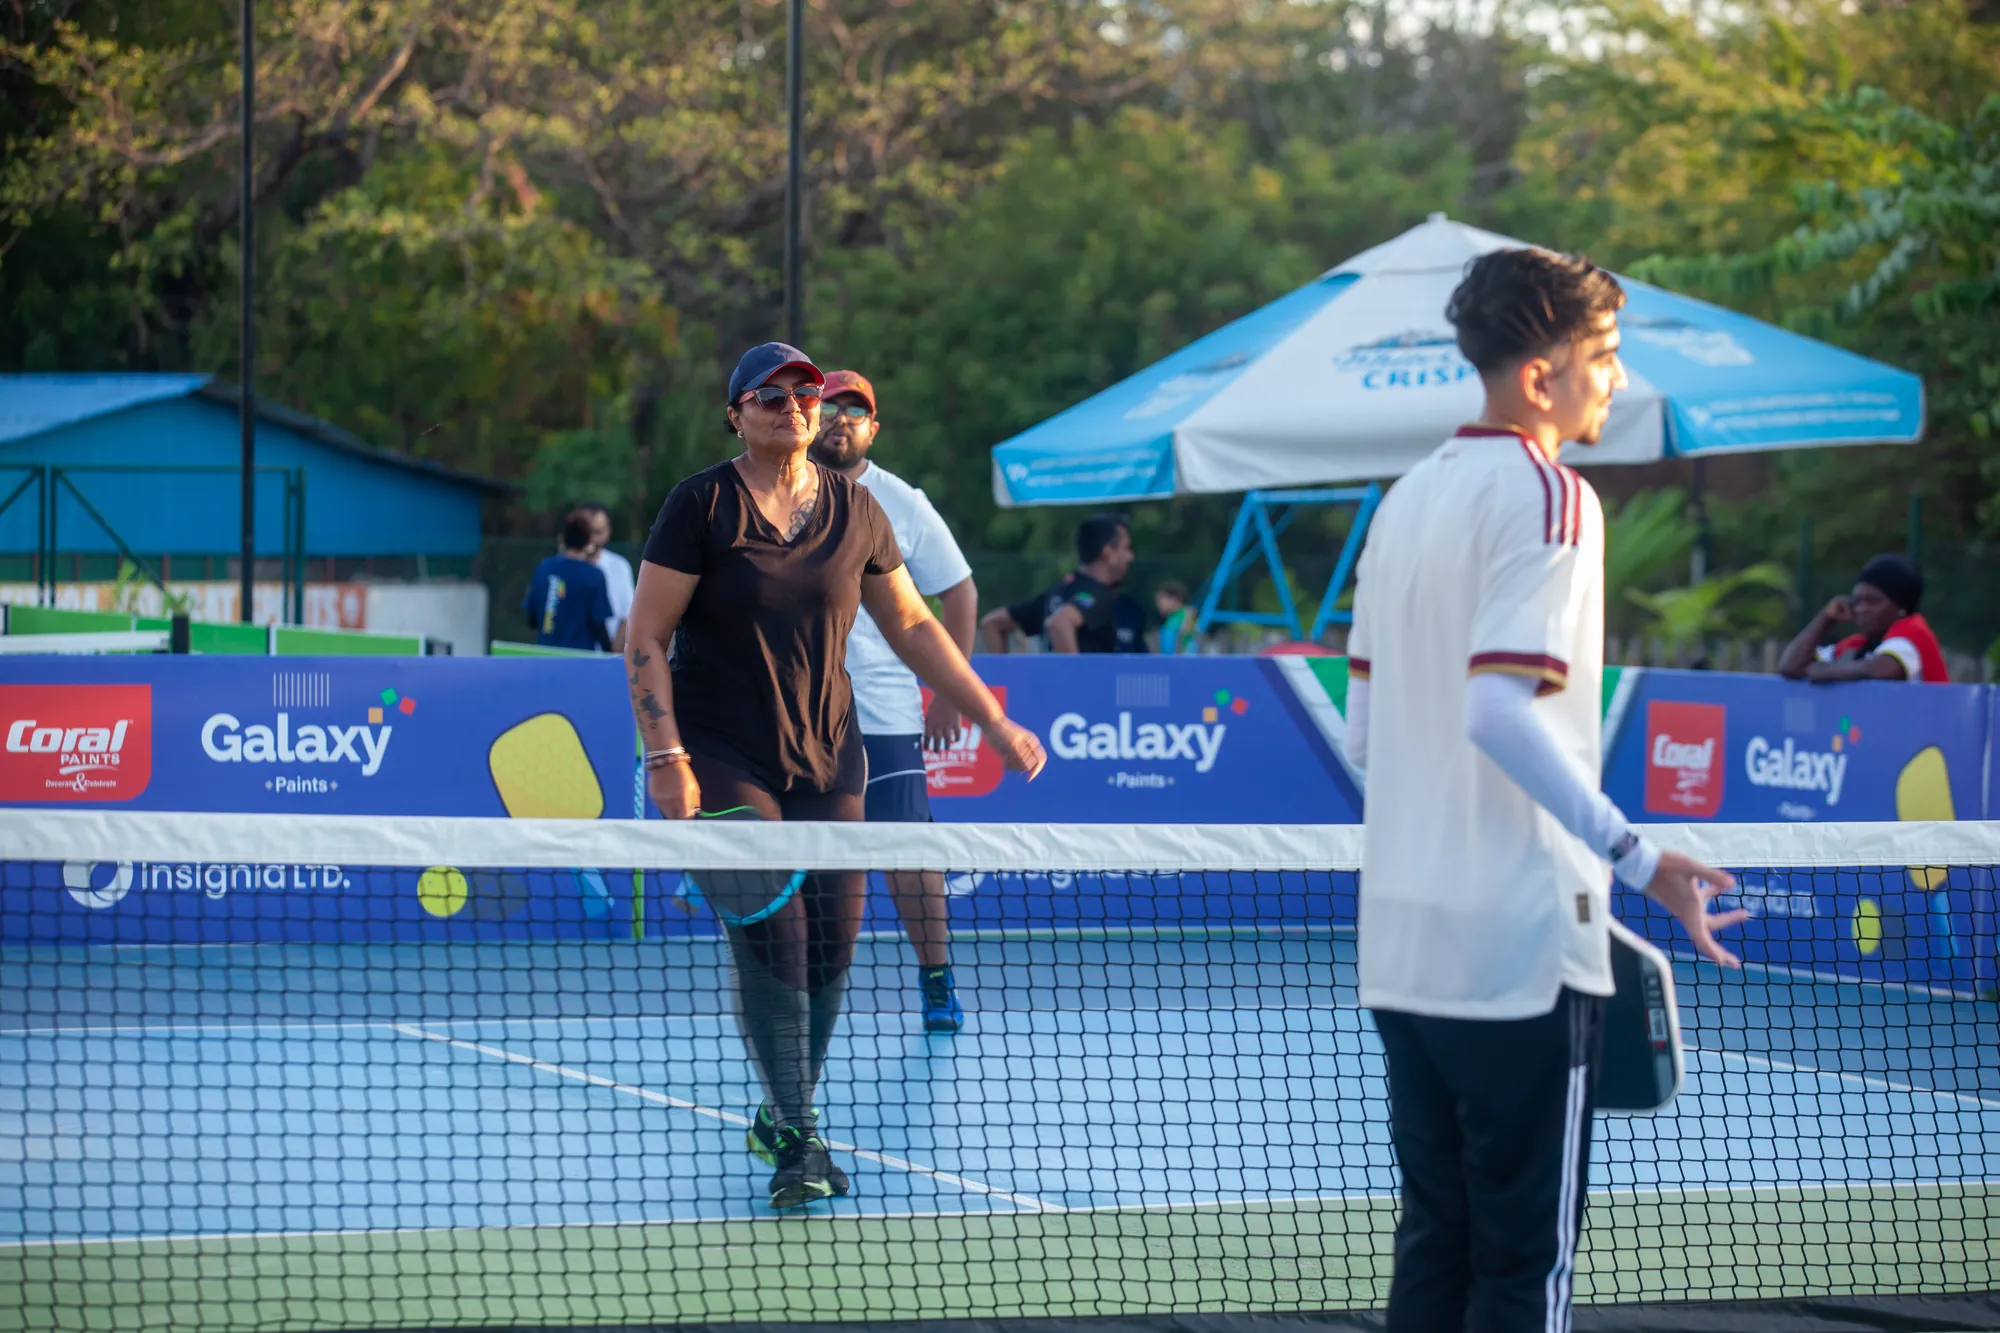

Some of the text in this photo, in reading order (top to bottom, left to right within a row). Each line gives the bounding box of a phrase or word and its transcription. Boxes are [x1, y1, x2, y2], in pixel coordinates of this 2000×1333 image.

[6, 719, 128, 753] Coral
[201, 713, 393, 776] Galaxy
[1049, 712, 1227, 773] Galaxy
[1652, 733, 1715, 769] Coral
[60, 753, 120, 765] PAINTS
[1745, 736, 1848, 806] Galaxy
[275, 776, 328, 793] Paints
[1116, 772, 1166, 788] Paints
